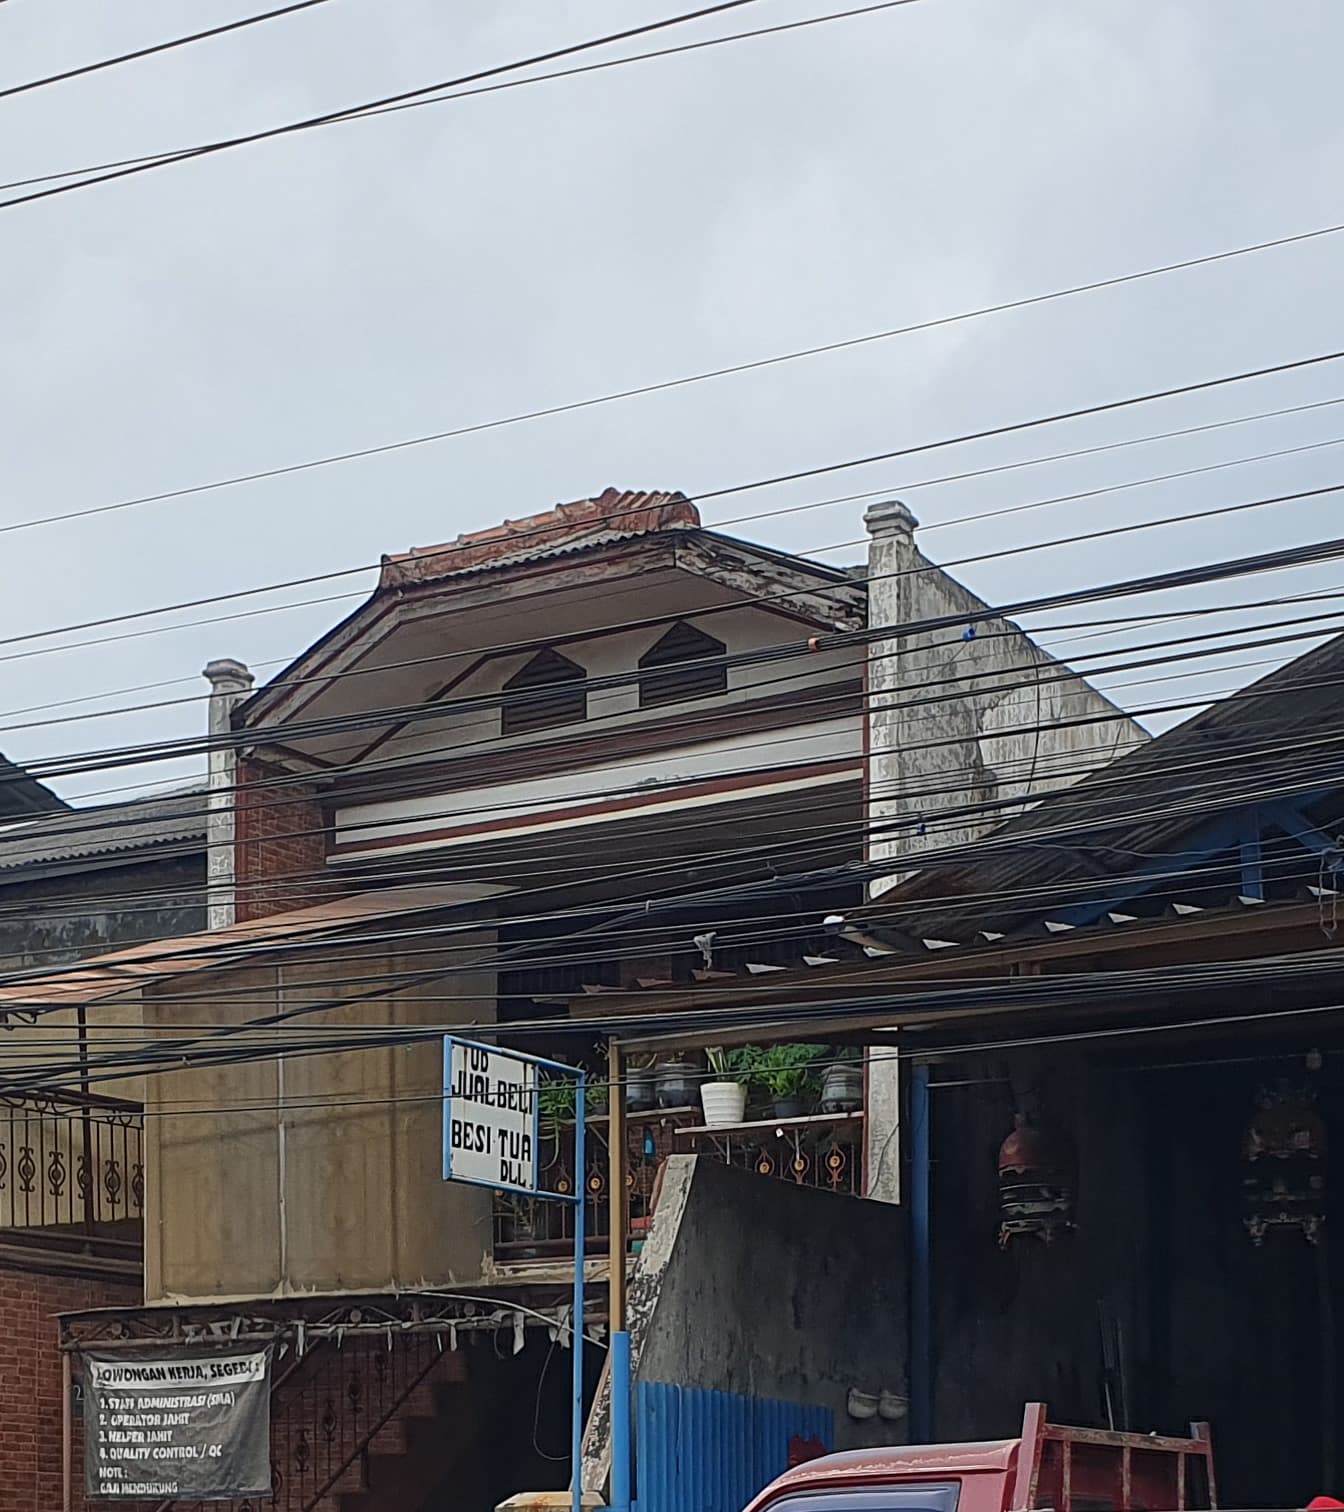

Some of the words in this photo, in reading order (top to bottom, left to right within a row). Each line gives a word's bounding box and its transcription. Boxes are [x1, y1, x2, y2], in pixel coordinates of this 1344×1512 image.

[451, 1070, 495, 1106] JUAL
[451, 1119, 491, 1154] BESI
[498, 1128, 532, 1162] TUA
[96, 1367, 166, 1383] LOWONGAN
[168, 1365, 207, 1381] KERJA,
[137, 1394, 206, 1410] ADMINISTRASI
[110, 1413, 161, 1426] OPERATOR
[162, 1412, 190, 1426] JAHIT
[108, 1430, 145, 1443] HELPER
[146, 1430, 173, 1442] JAHIT
[109, 1447, 150, 1460] QUALITY
[152, 1445, 199, 1460] CONTROL
[208, 1444, 223, 1457] QC
